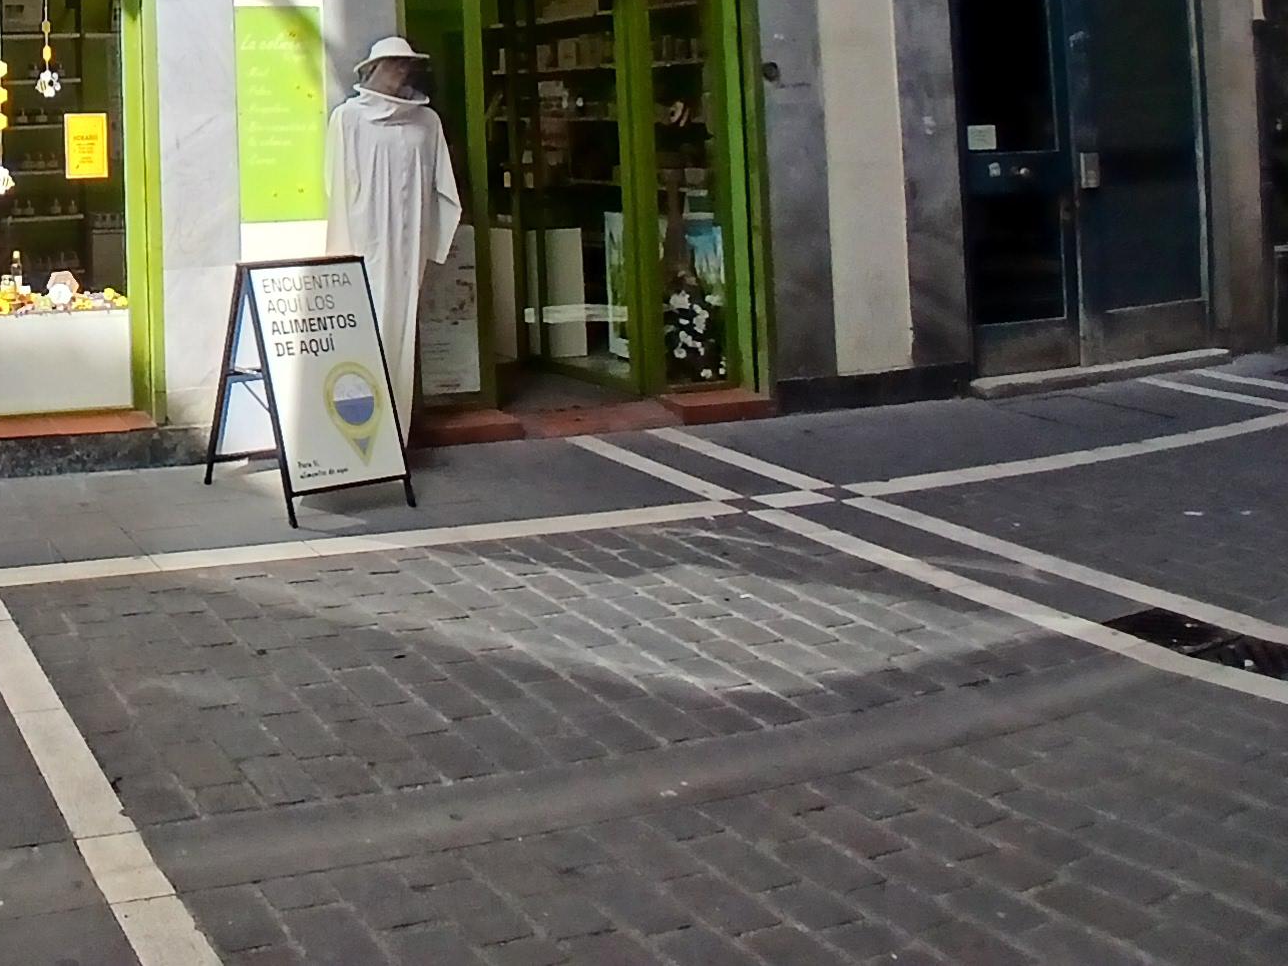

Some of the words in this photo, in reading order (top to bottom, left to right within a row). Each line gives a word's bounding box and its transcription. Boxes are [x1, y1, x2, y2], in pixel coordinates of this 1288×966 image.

[262, 272, 351, 294] ENCUENTRA
[306, 294, 336, 312] LOS
[271, 313, 357, 335] ALIMENTOS
[275, 341, 295, 357] DE
[300, 333, 335, 356] AQUÍ
